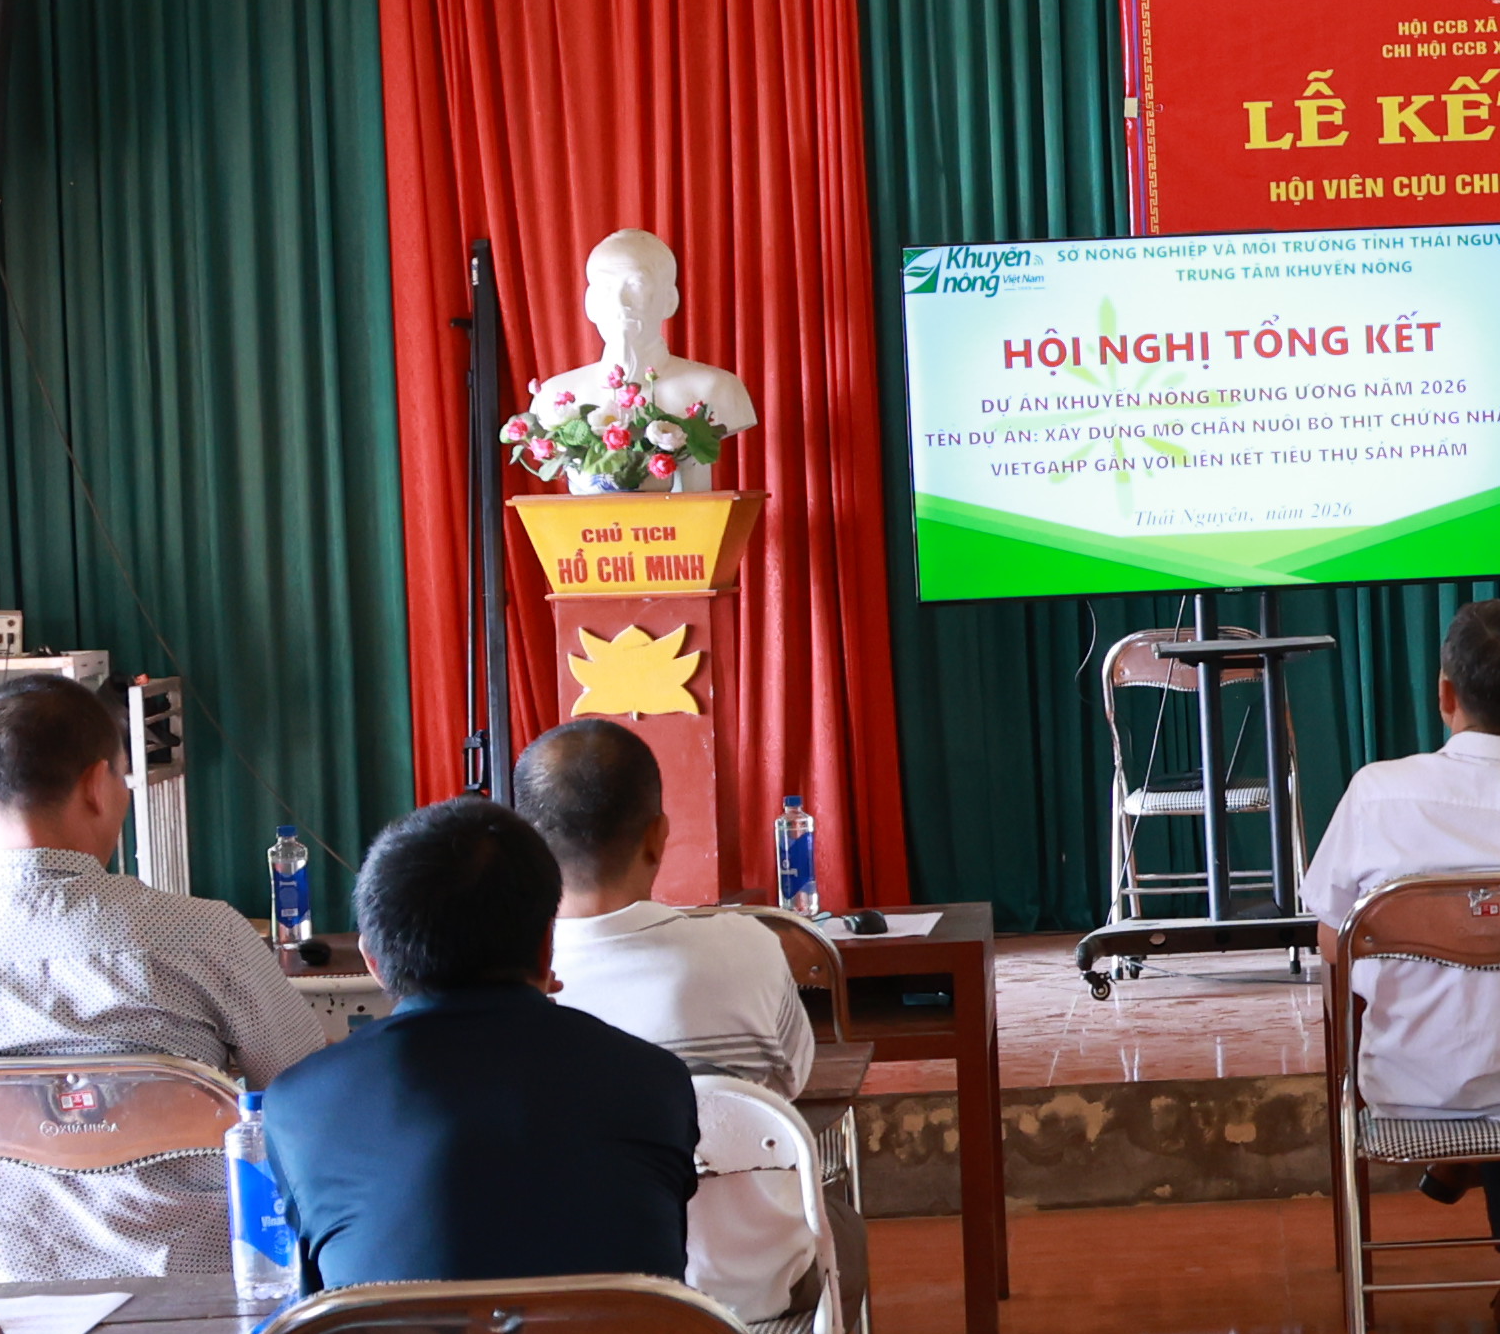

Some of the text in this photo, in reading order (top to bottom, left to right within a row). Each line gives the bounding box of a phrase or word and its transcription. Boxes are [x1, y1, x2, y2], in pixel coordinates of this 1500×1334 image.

[1398, 19, 1427, 38] HỘI
[1434, 20, 1468, 34] CCB
[1475, 17, 1497, 33] XÃ
[1382, 44, 1411, 58] CHI
[1418, 40, 1446, 58] HỘI
[1453, 41, 1487, 55] CCB
[1243, 69, 1349, 149] LỄ
[1270, 177, 1314, 205] HỘI
[1323, 174, 1383, 199] VIÊN
[1393, 174, 1446, 200] CỰU
[1057, 246, 1078, 262] SỞ
[1086, 245, 1136, 261] NÔNG
[1143, 241, 1207, 260] NGHIỆP
[1213, 238, 1235, 256] VÀ
[1243, 239, 1276, 255] MÔI
[1282, 236, 1356, 253] TRƯỜNG
[1364, 233, 1404, 249] TỈNH
[1410, 231, 1450, 248] THÁI
[943, 272, 999, 297] nông
[1003, 275, 1044, 286] Việt Nam
[1176, 258, 1412, 281] TRUNG TÂM KHUYẾN NÔNG
[1004, 310, 1442, 375] HỘI NGHỊ TỔNG KẾT
[981, 378, 1466, 417] DỰ ÁN KHUYẾN NÔNG TRUNG ƯƠNG NĂM 2026
[925, 428, 961, 447] TÊN
[969, 430, 998, 448] DỰ
[1004, 426, 1038, 443] ÁN:
[1045, 424, 1081, 441] XÂY
[1089, 423, 1146, 443] DỰNG
[1153, 418, 1183, 436] MÔ
[1191, 417, 1245, 435] CHĂN
[1253, 413, 1300, 432] NUÔI
[1308, 412, 1333, 430] BÒ
[1340, 414, 1383, 432] THỊT
[1391, 408, 1459, 427] CHỨNG
[991, 437, 1467, 476] VIETGAHP GẮN VỚI LIÊN KẾT TIÊU THỤ SẢN PHẨM
[1135, 510, 1174, 526] Thái
[1266, 505, 1303, 519] năm
[1310, 502, 1352, 518] 2026
[582, 523, 676, 543] CHỦ TỊCH
[558, 548, 705, 584] HỒ CHÍ MINH
